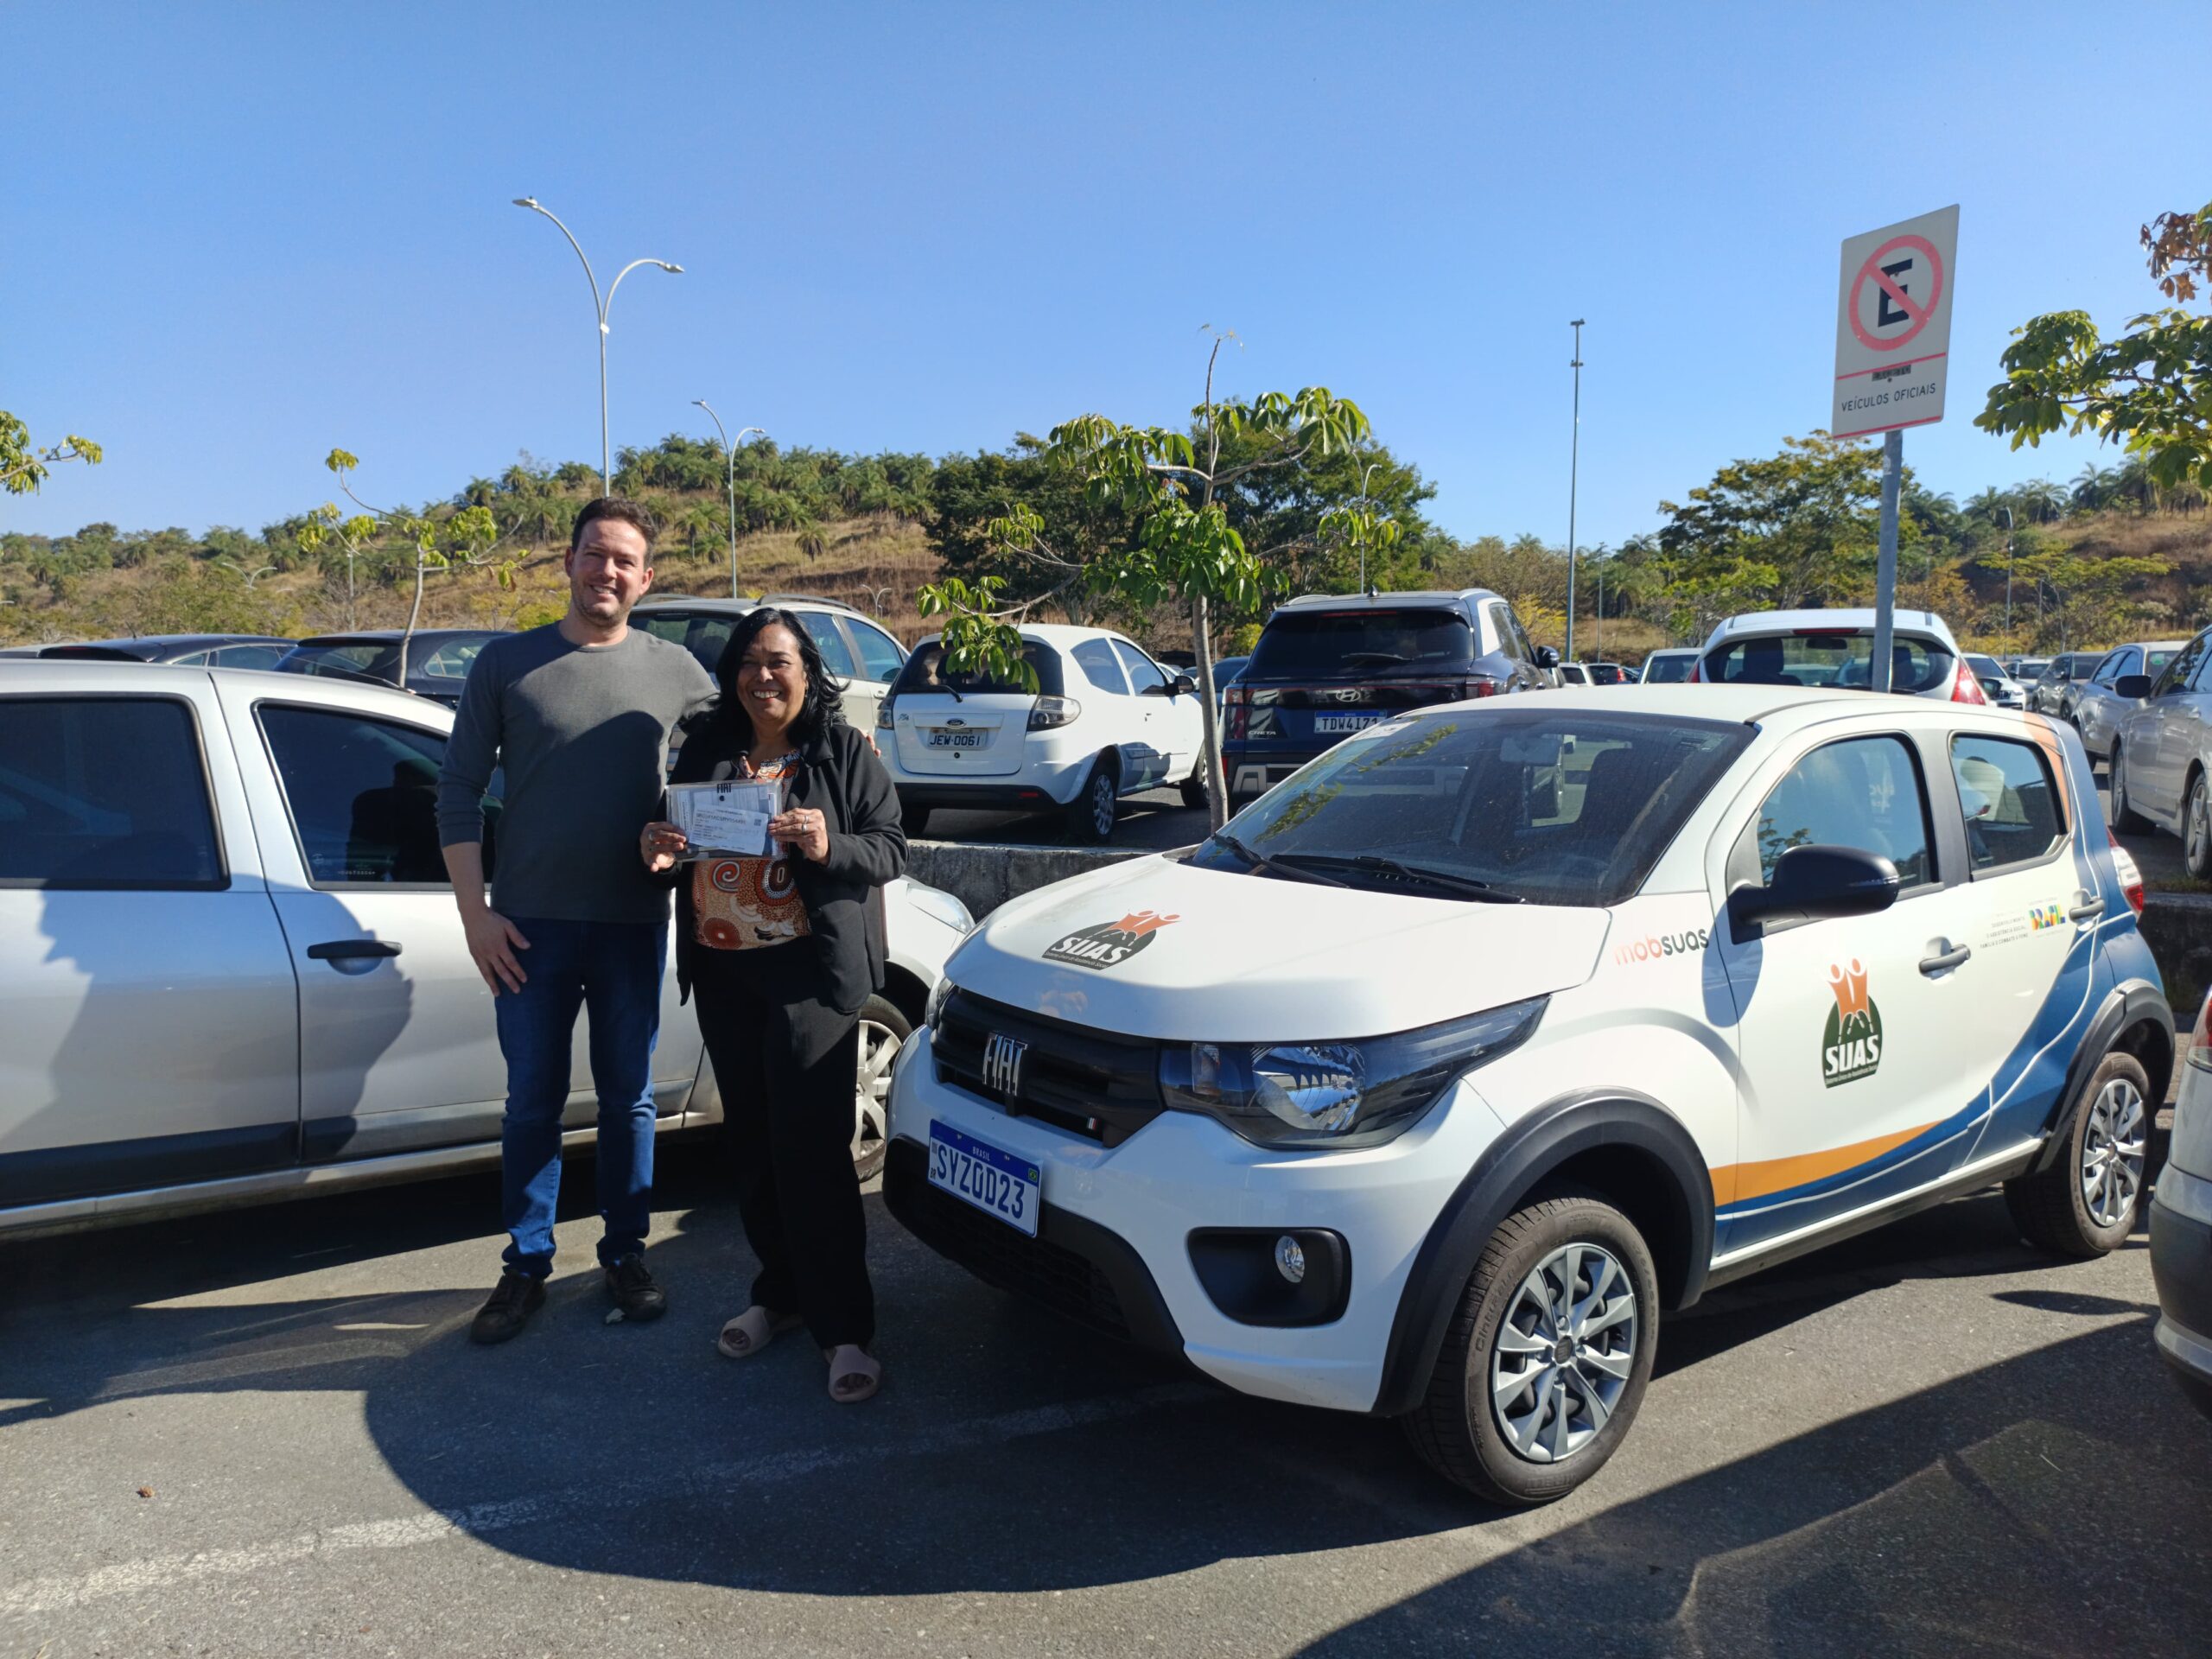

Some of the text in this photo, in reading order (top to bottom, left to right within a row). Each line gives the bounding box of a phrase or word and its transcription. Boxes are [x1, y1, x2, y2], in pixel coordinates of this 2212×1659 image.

[1841, 383, 1936, 412] VEÍCULOS OFICIAIS
[716, 783, 732, 793] FIAT
[1051, 937, 1132, 963] SUAS
[1613, 929, 1709, 965] mobsuas
[982, 1033, 1028, 1097] FIAT
[1825, 1034, 1879, 1077] SUAS
[972, 1146, 991, 1161] BRASIL
